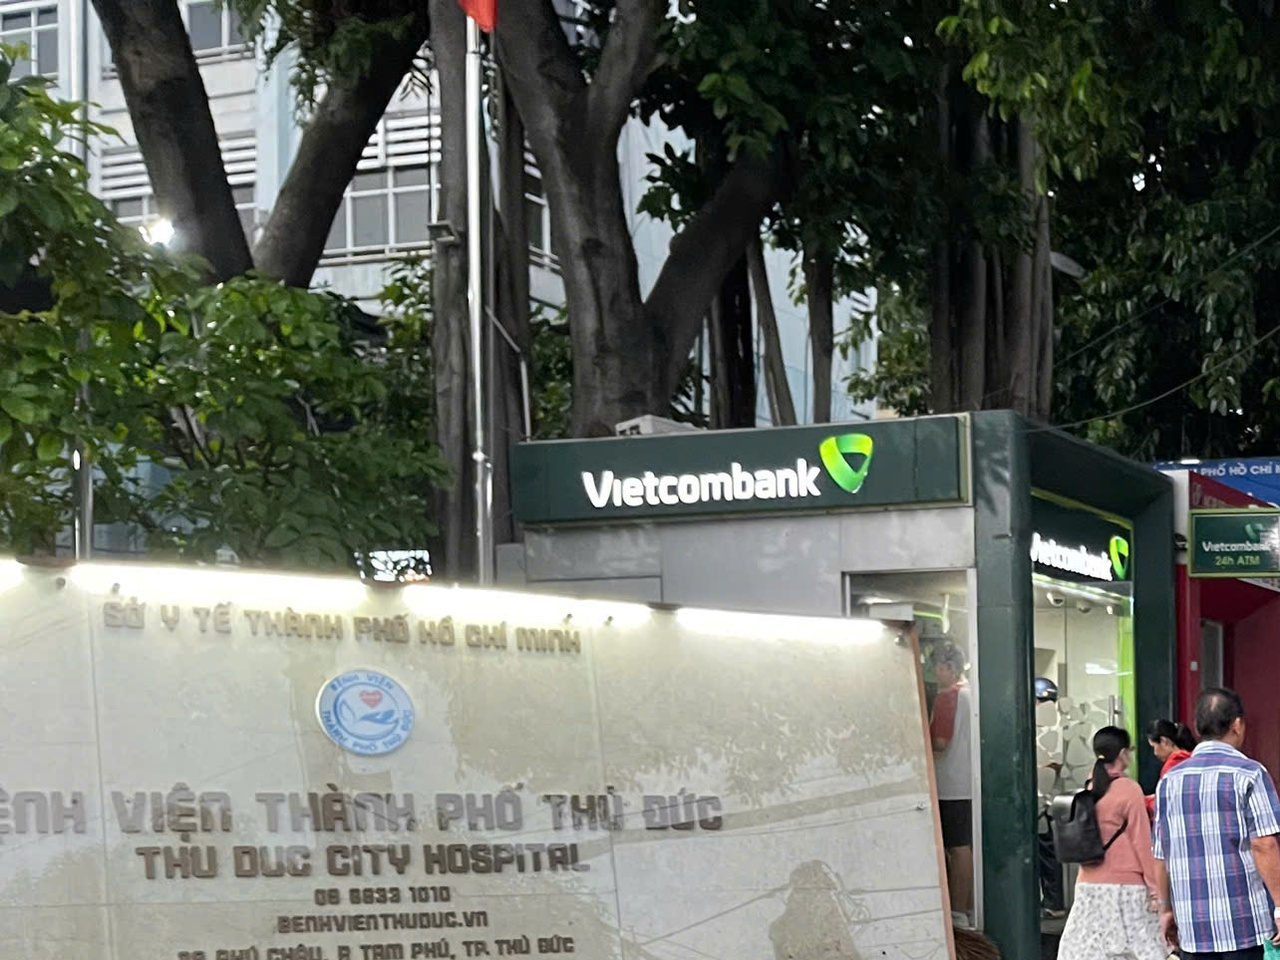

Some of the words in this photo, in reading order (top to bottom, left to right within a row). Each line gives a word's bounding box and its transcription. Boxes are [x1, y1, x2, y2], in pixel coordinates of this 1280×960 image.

[582, 457, 821, 508] Vietcombank
[1201, 541, 1273, 553] Vietcombank
[1214, 555, 1234, 566] 24h
[1236, 555, 1261, 566] ATM
[160, 604, 180, 633] Y
[243, 607, 343, 641] THÀNH
[516, 627, 581, 654] MINH
[111, 782, 233, 843] VIỆN
[254, 783, 416, 832] THÀNH
[435, 782, 524, 832] PHỐ
[135, 845, 218, 879] THU
[232, 844, 312, 878] DUC
[326, 844, 411, 876] CITY
[424, 843, 591, 875] HOSPITAL
[408, 885, 451, 904] 1010
[277, 911, 489, 934] BENHVIENTHUDUC.VN
